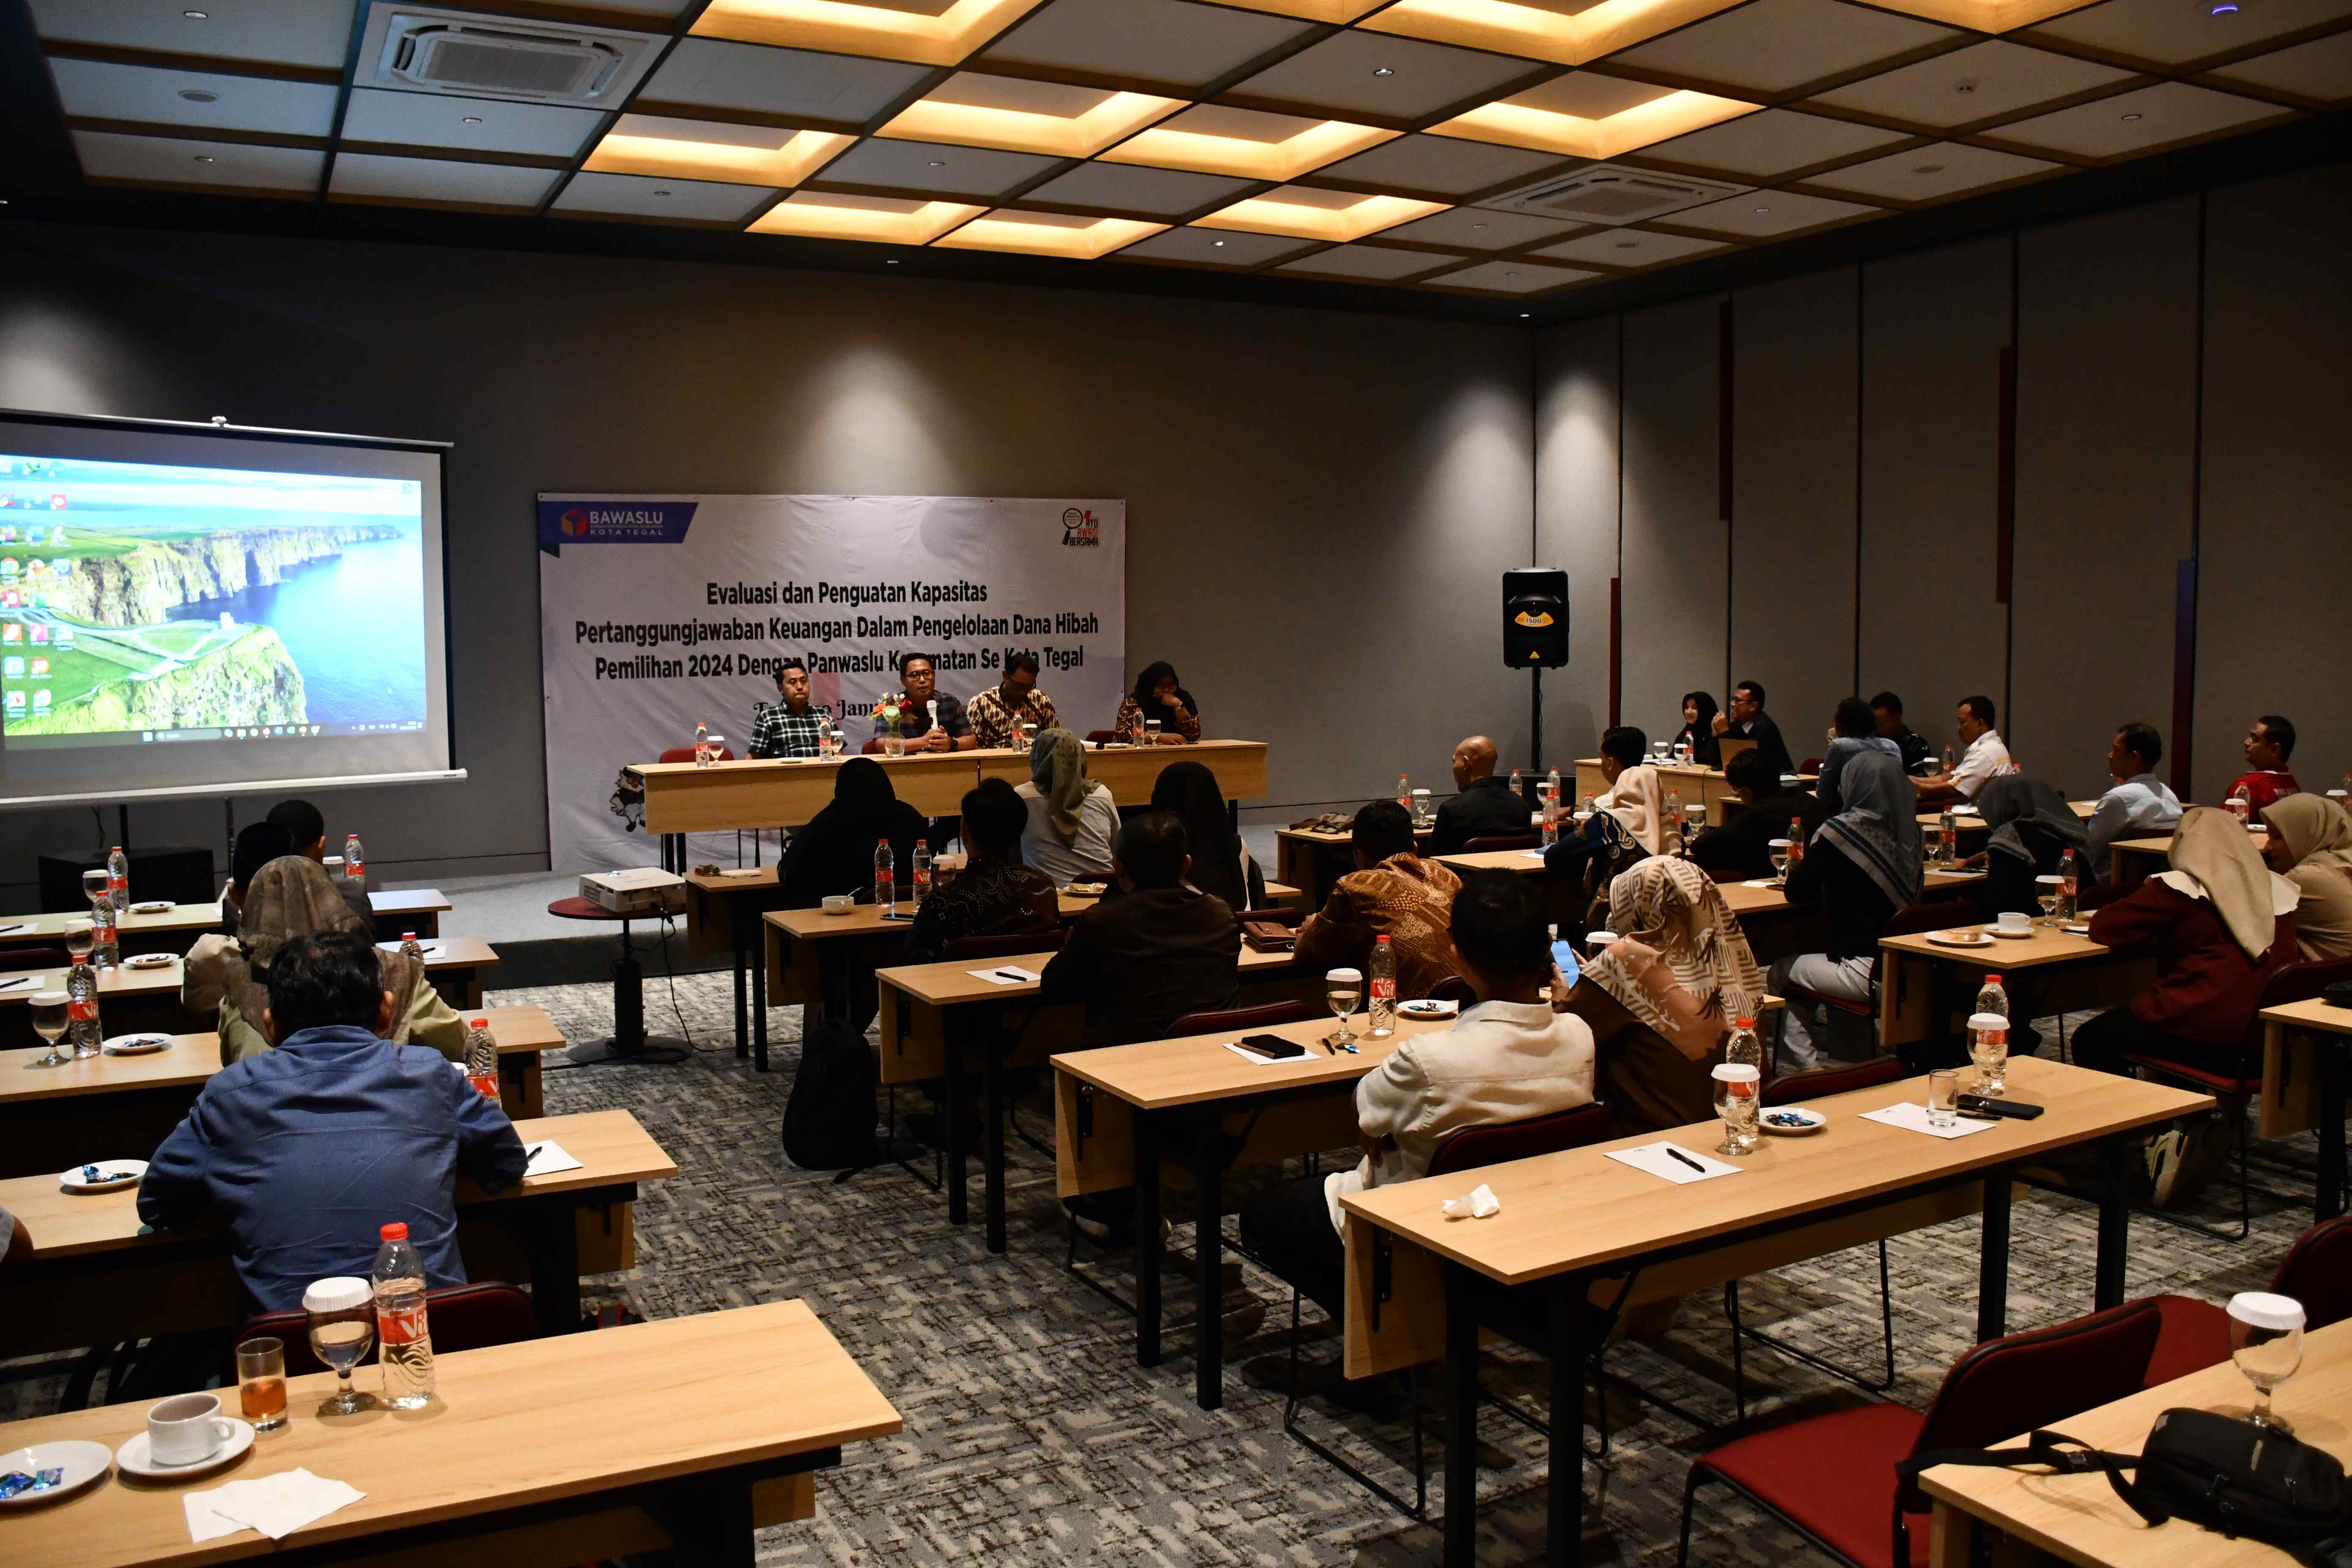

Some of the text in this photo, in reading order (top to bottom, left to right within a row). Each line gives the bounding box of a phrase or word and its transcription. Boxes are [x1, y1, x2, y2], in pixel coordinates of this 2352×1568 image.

[590, 511, 663, 524] BAWASLU
[1070, 537, 1098, 546] BERSAMA
[707, 580, 987, 607] Evaluasi dan Penguatan Kapasitas
[576, 612, 1098, 647] Pertanggungjawaban Keuangan Dalam Pengelolaan Dana Hibah
[596, 655, 683, 679] Pemilihan
[688, 654, 733, 677] 2024
[808, 650, 884, 673] Panwaslu
[889, 649, 976, 671] Kmatan
[981, 648, 1000, 669] Se
[1043, 645, 1083, 671] Tegal
[1377, 980, 1395, 996] Vit
